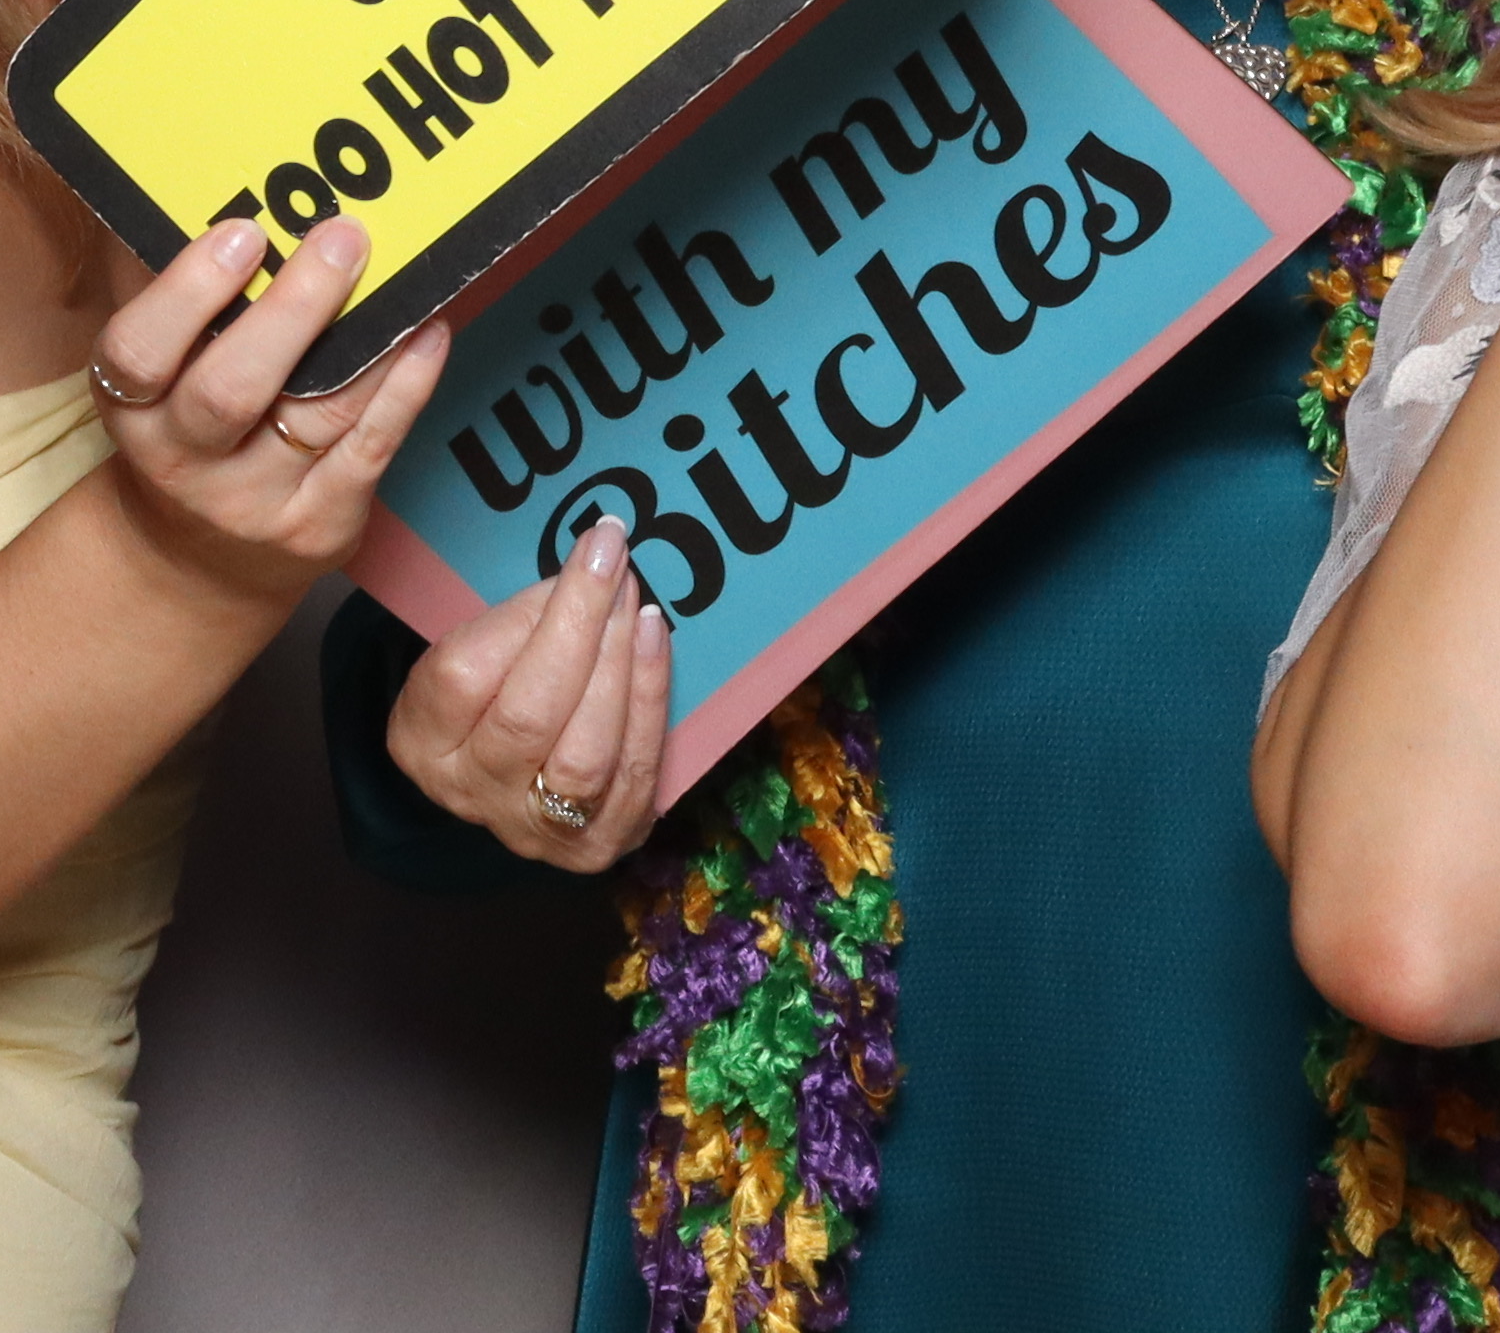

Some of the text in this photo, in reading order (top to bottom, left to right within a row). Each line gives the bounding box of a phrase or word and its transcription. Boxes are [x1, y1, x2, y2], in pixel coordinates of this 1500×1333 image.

[447, 10, 1029, 513] with my
[537, 130, 1173, 633] Bitches
